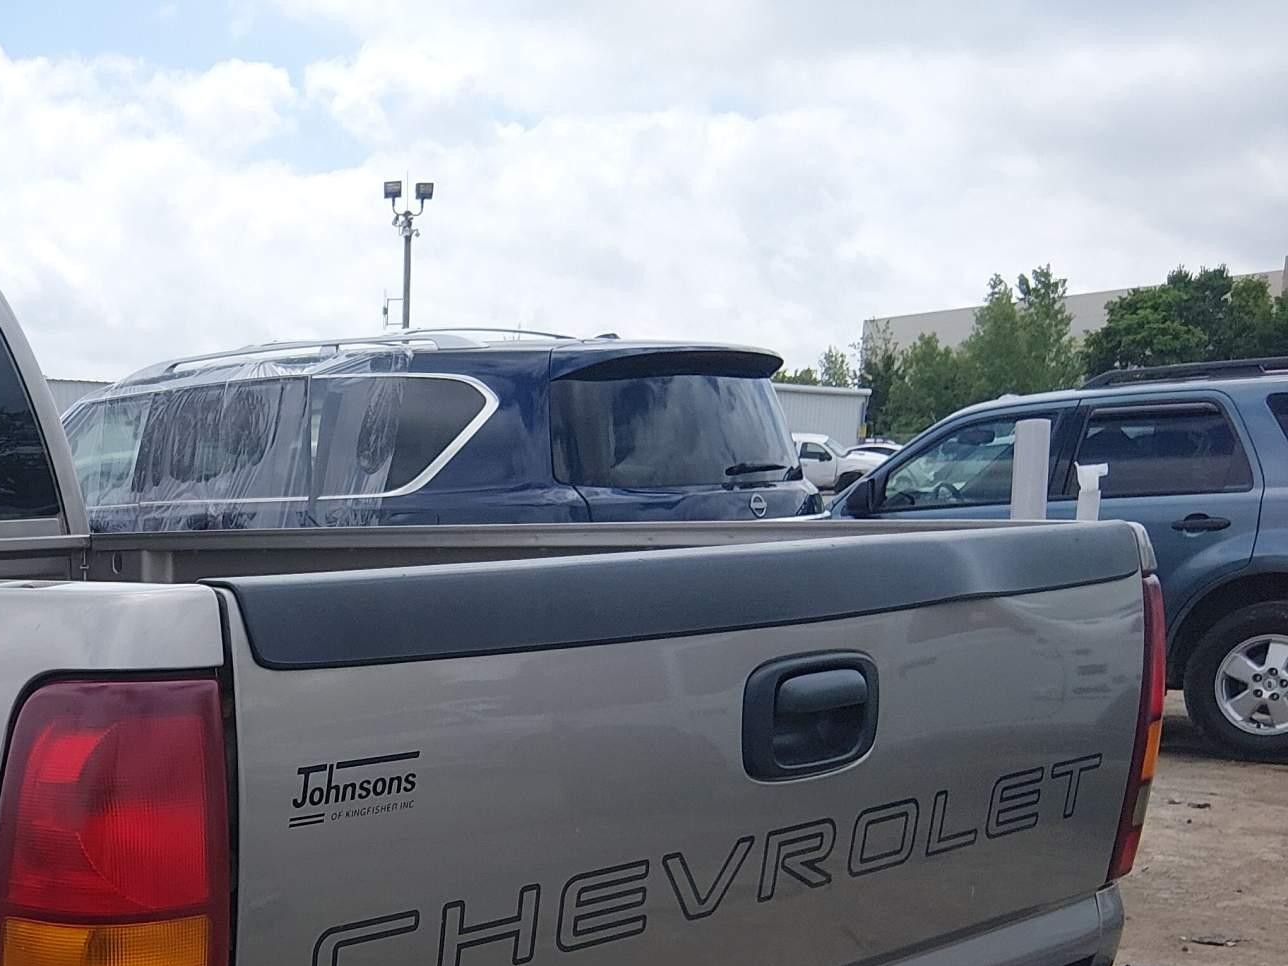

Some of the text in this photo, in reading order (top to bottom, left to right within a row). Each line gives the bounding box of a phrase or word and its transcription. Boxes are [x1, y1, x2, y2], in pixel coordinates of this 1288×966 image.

[292, 762, 418, 809] Johnsons
[330, 799, 415, 821] OF KINGFISHER INC
